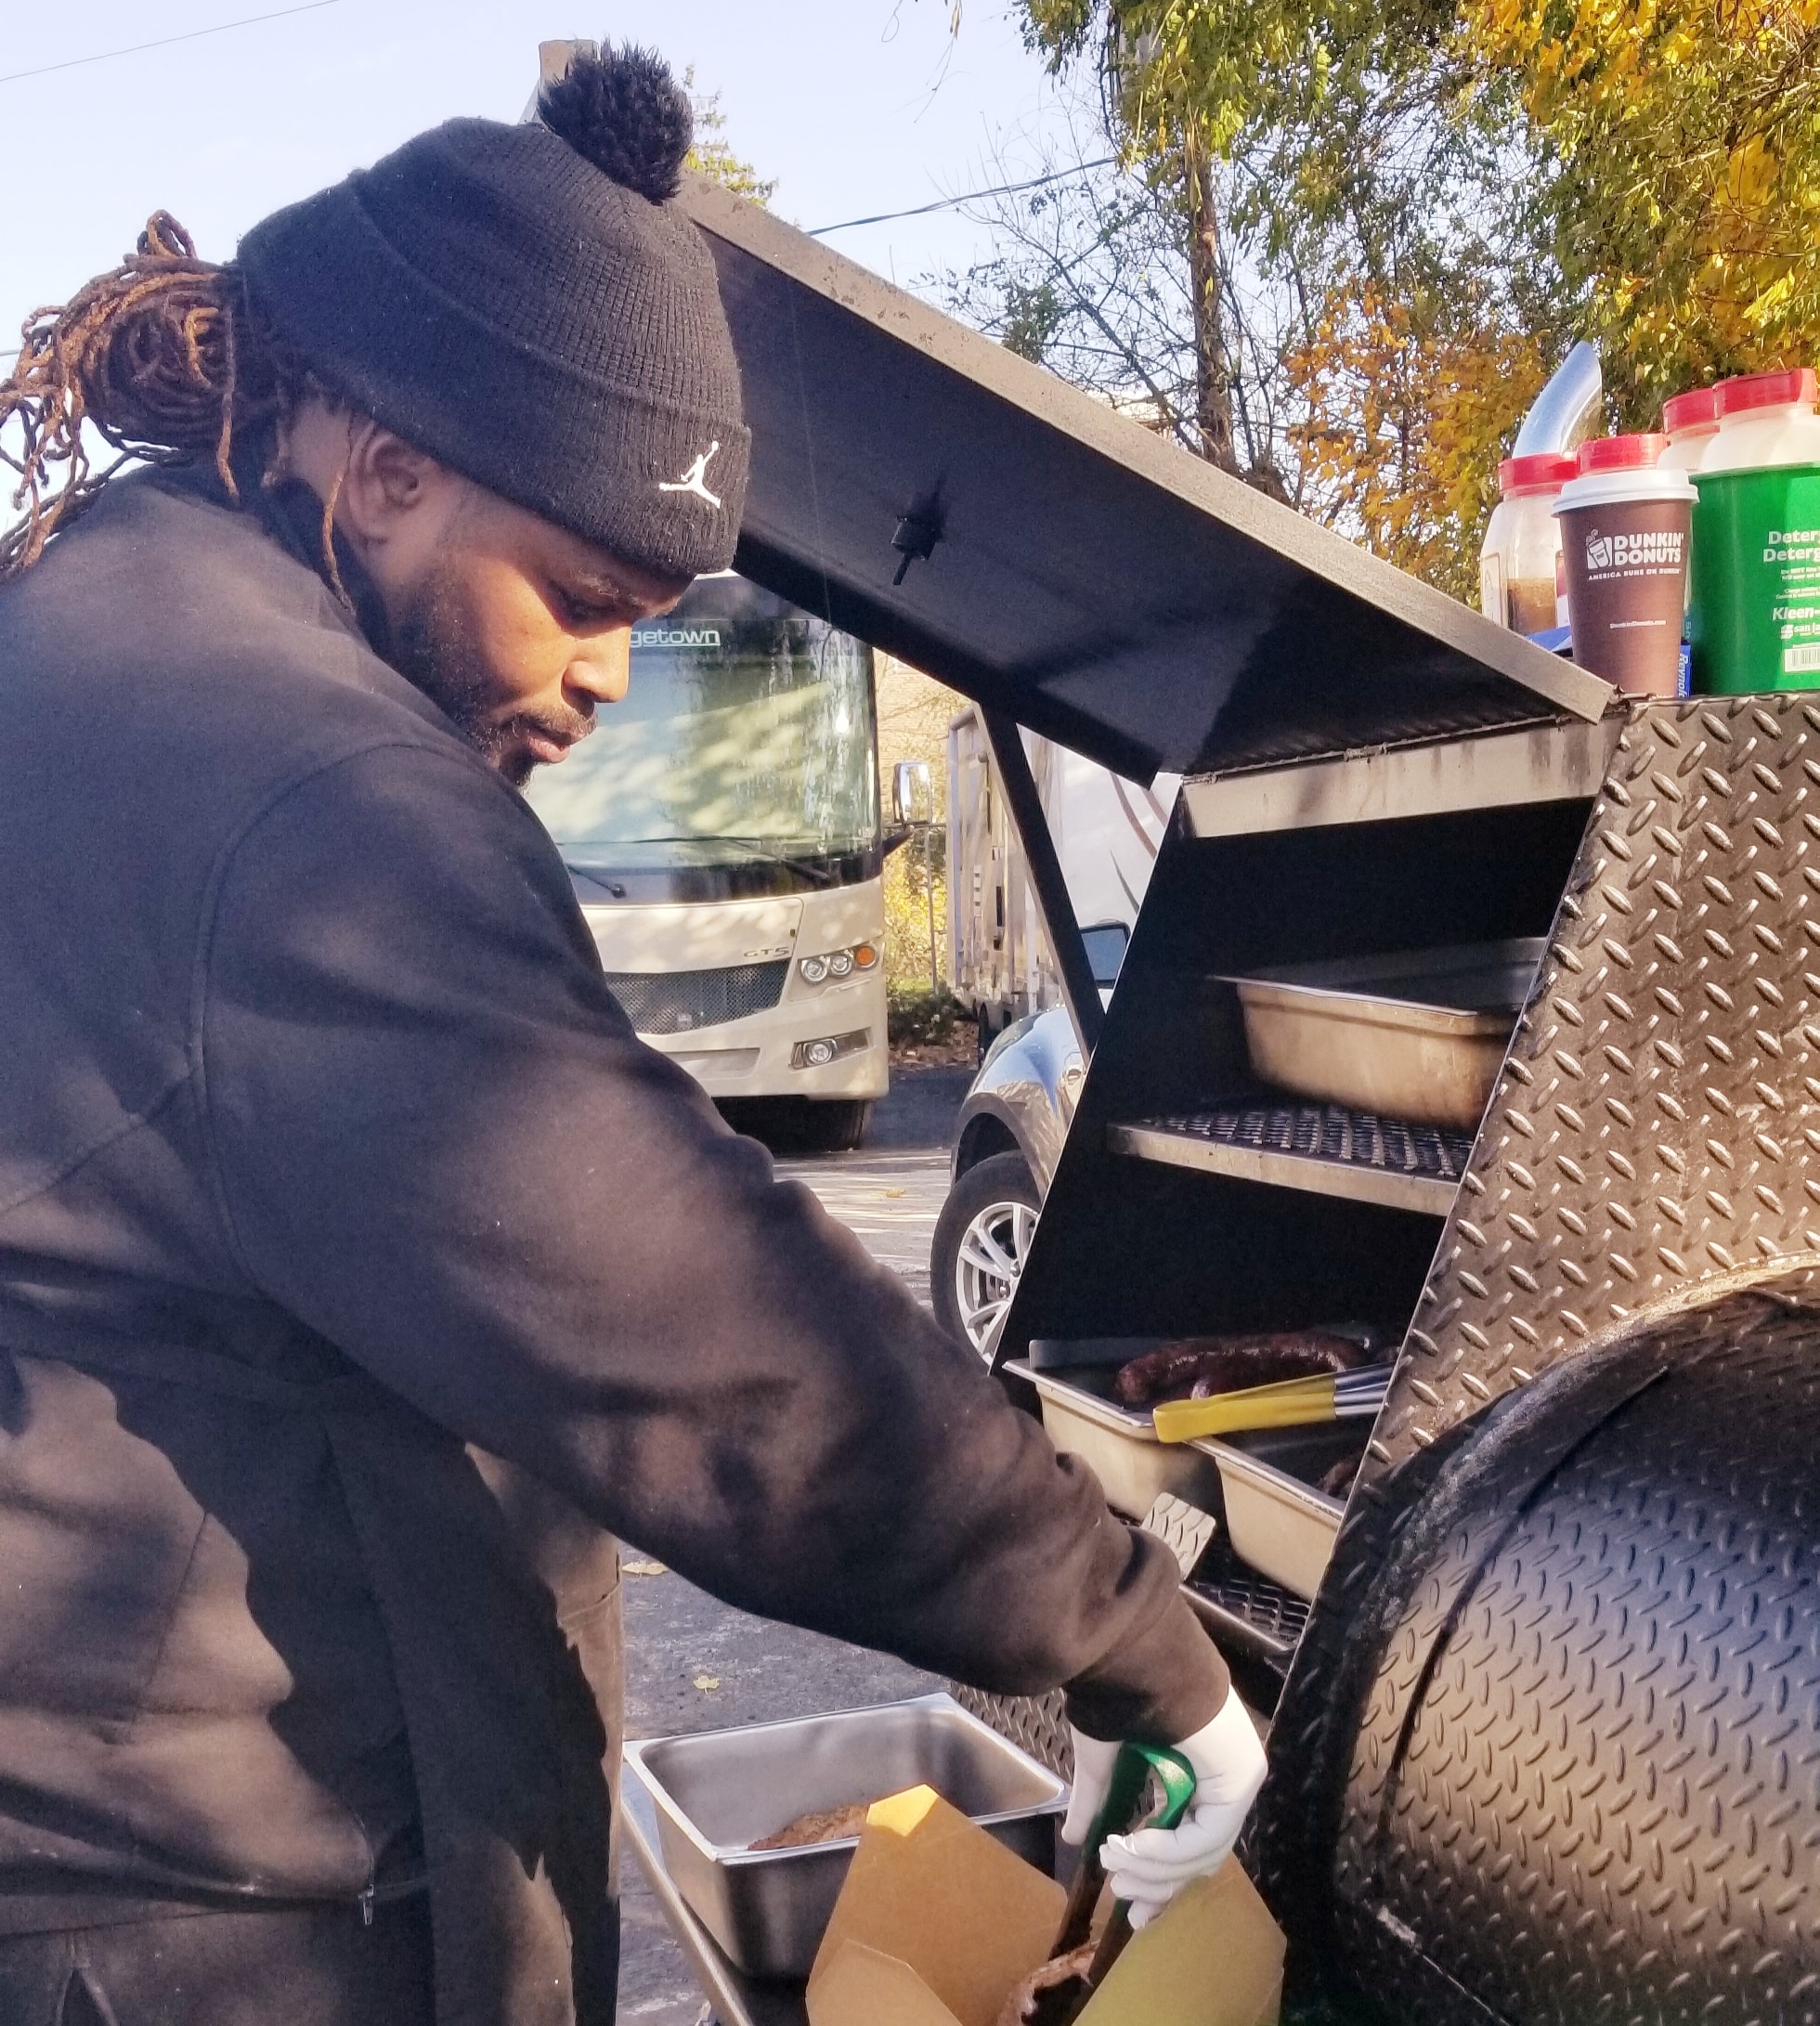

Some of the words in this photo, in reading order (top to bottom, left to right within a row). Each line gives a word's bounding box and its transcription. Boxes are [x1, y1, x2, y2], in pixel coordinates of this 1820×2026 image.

[1614, 533, 1684, 551] DUNKIN'
[1614, 548, 1681, 565] DONUTS
[1588, 572, 1621, 580] AMERICA
[743, 946, 789, 957] GTS
